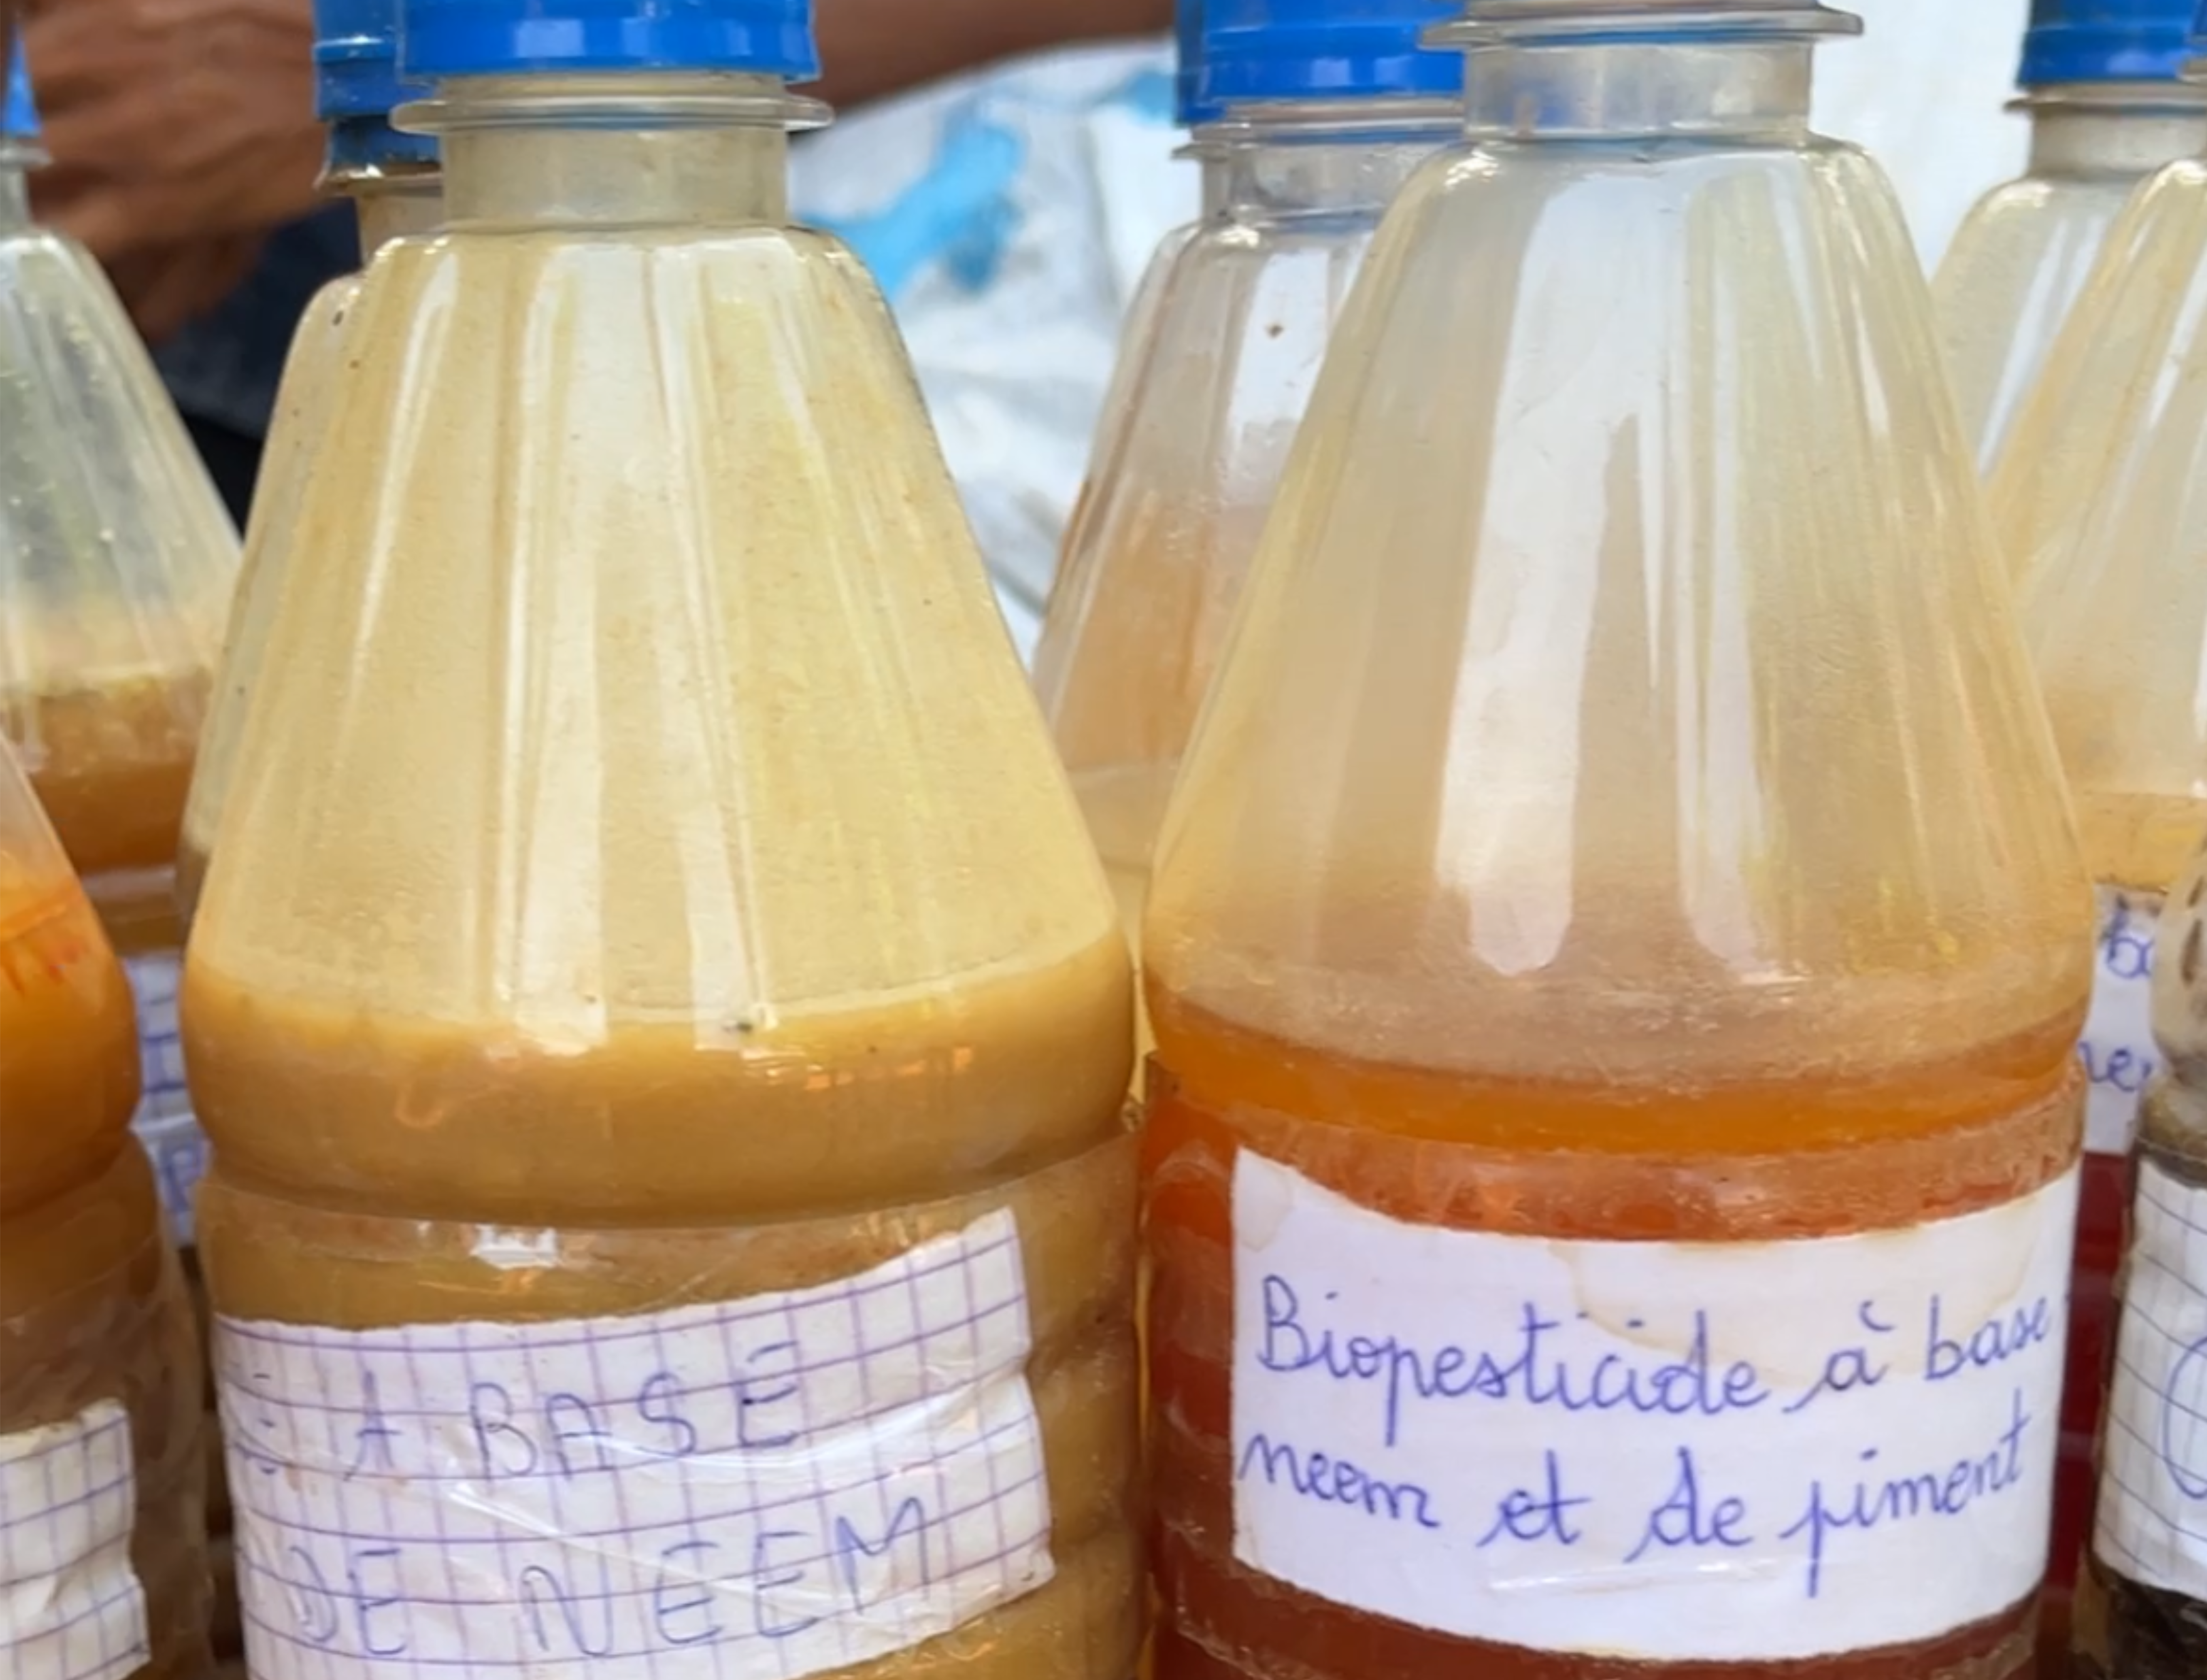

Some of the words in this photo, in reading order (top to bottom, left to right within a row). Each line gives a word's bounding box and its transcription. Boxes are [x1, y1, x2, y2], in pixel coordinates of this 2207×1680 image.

[343, 1371, 404, 1482] A
[470, 1340, 799, 1481] BASE
[1256, 1274, 1771, 1447] Biopesticide
[1781, 1299, 1898, 1414] à
[1924, 1293, 2049, 1380] base
[1237, 1433, 1440, 1528] neem
[1475, 1449, 1594, 1549] et
[1622, 1446, 1754, 1565] de
[1778, 1387, 2032, 1598] piment
[288, 1545, 409, 1656] DE
[518, 1496, 930, 1658] NEEM
